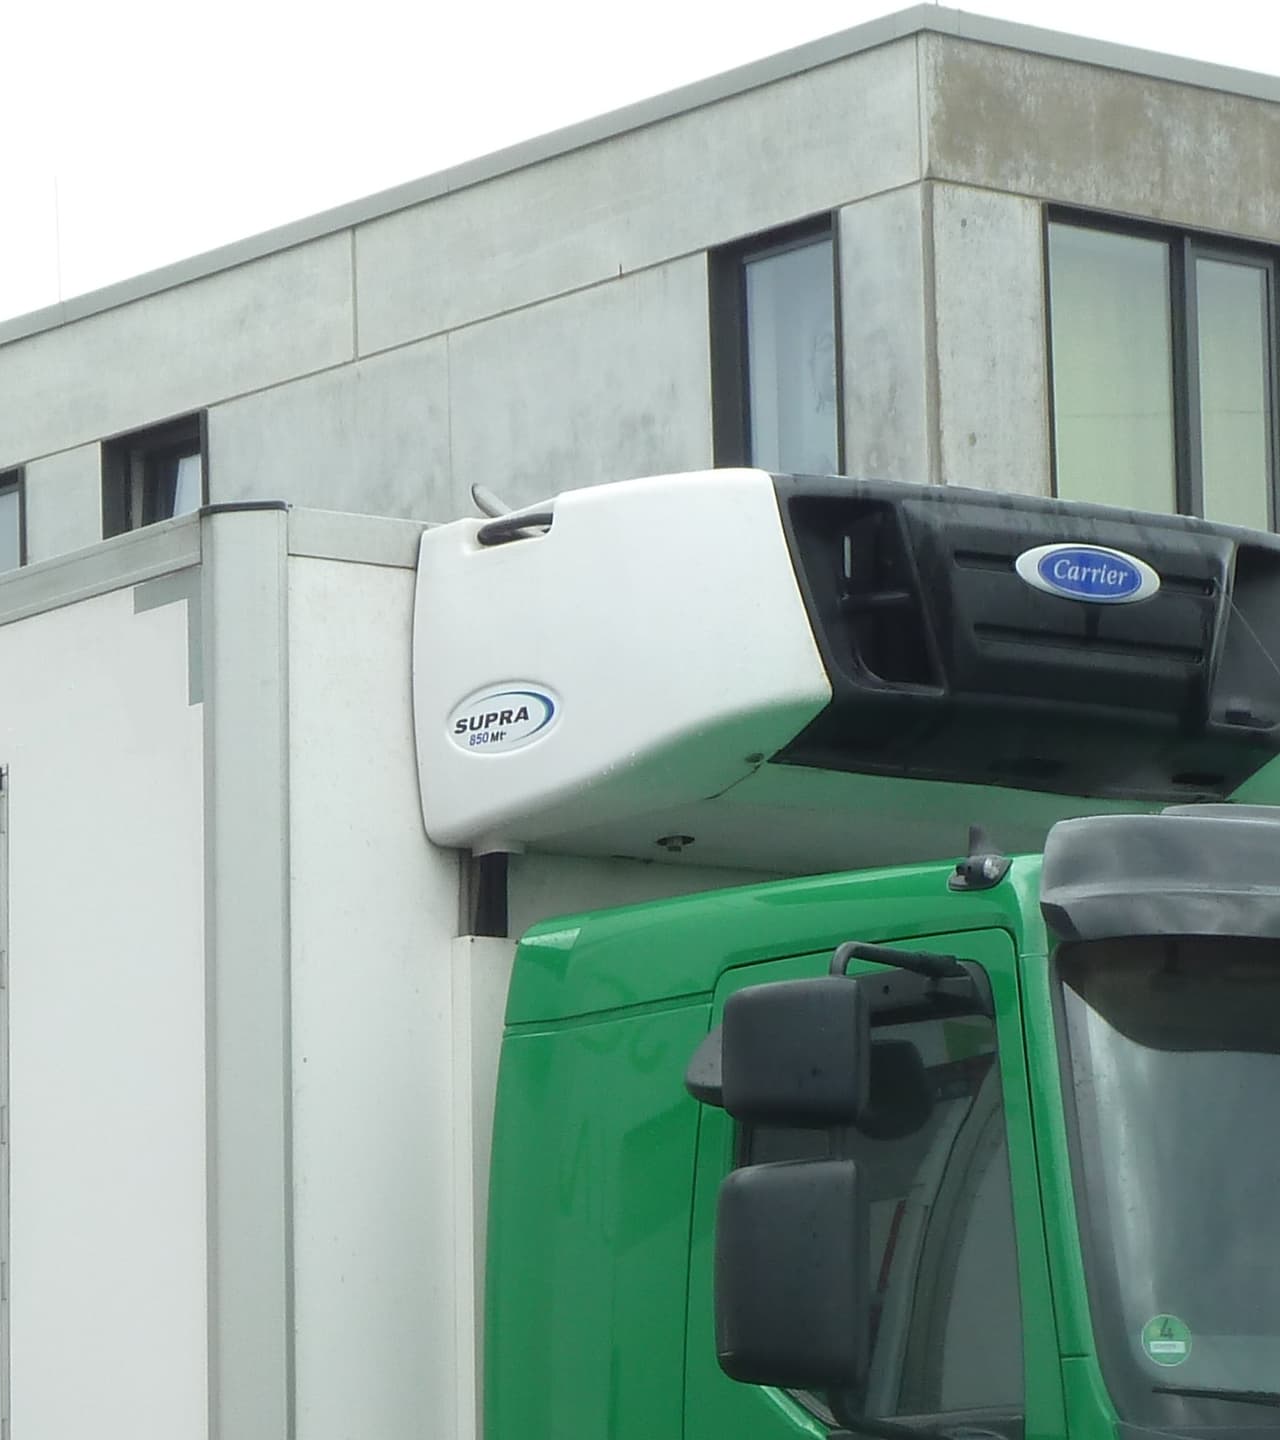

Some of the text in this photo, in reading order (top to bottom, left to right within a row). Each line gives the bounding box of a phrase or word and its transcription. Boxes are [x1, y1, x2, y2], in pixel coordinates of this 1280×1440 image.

[1053, 559, 1128, 585] Carrier
[454, 706, 529, 734] SUPRA
[469, 732, 489, 746] 850
